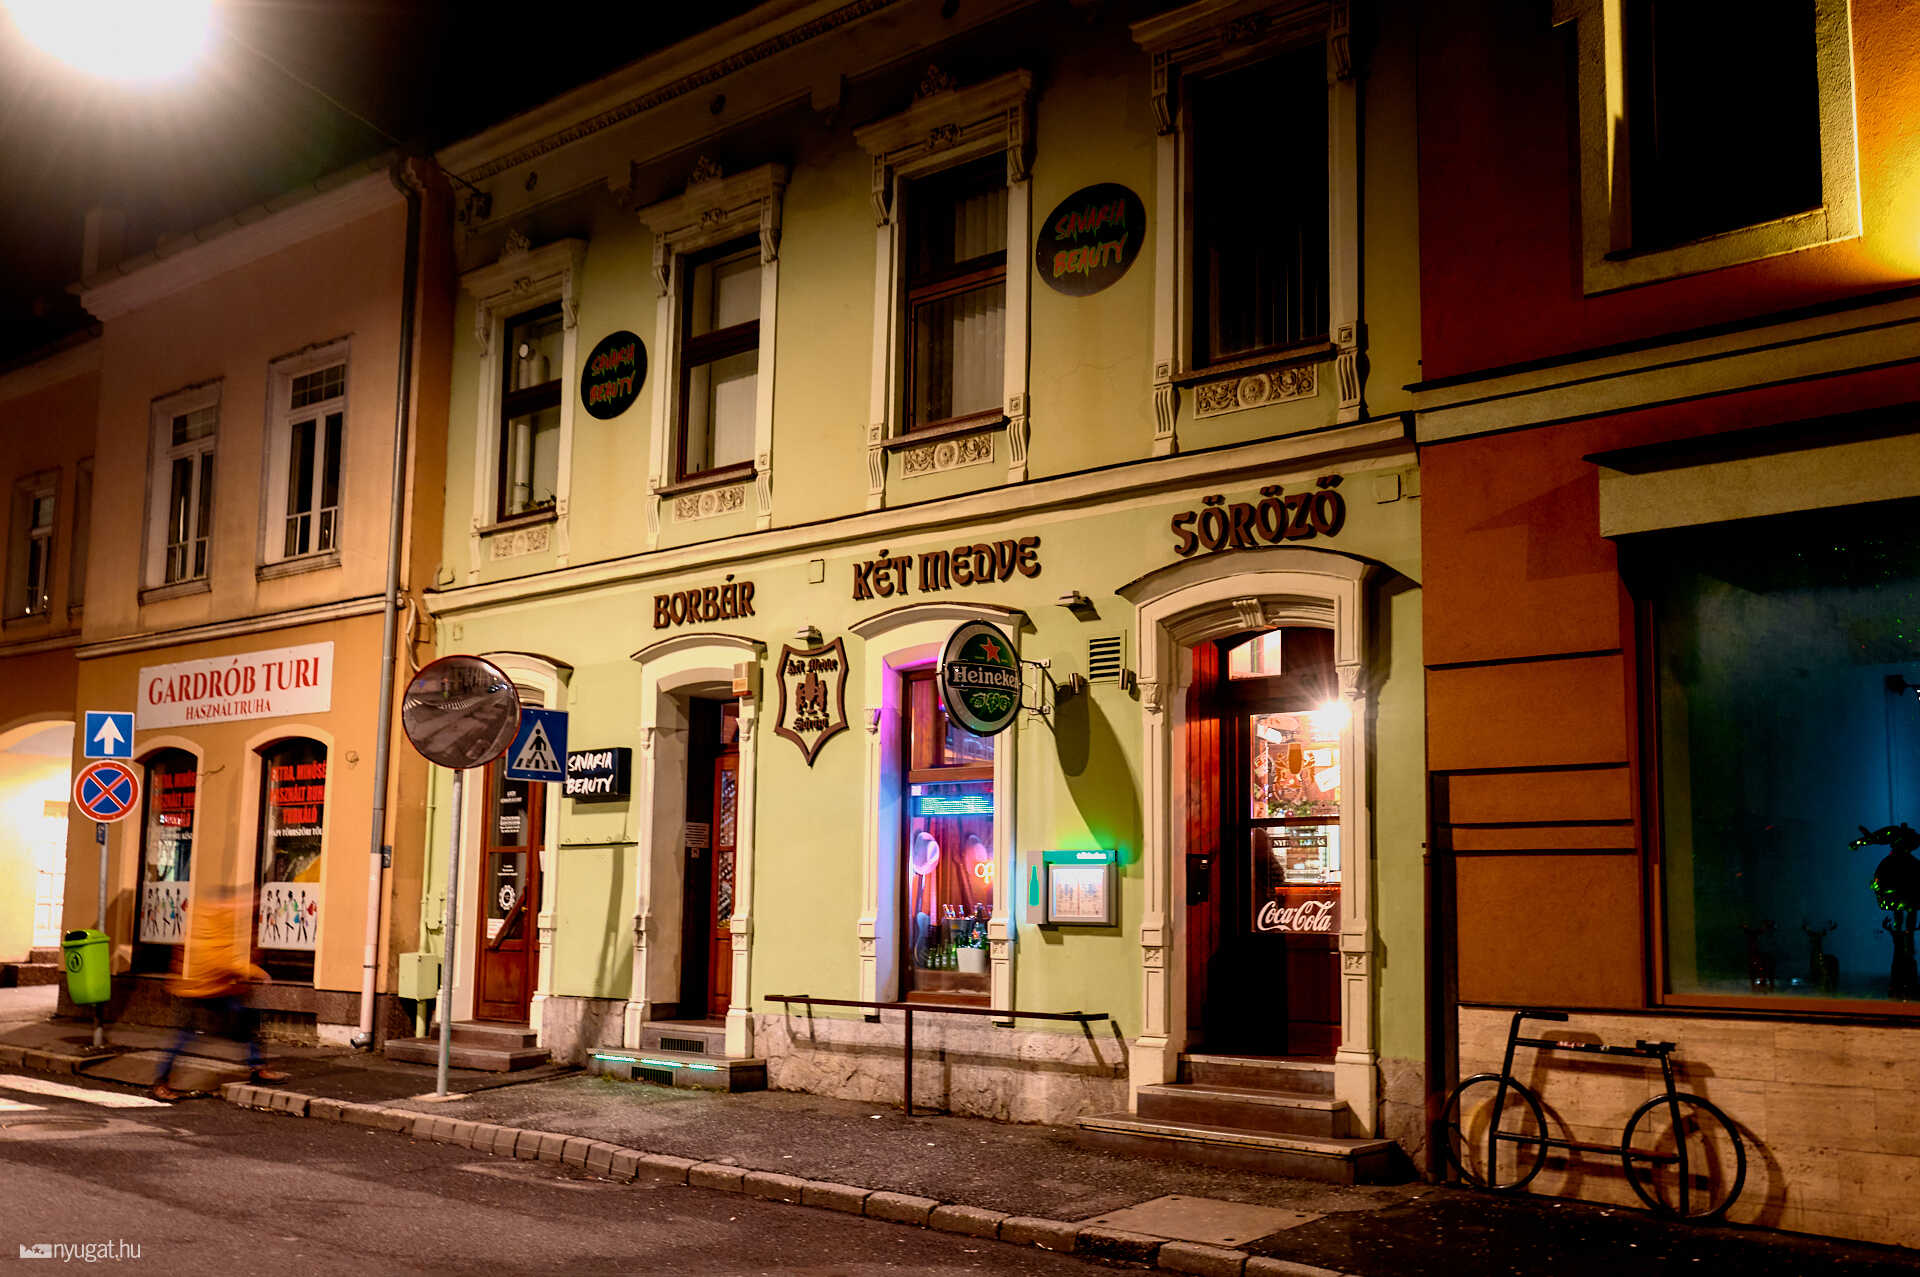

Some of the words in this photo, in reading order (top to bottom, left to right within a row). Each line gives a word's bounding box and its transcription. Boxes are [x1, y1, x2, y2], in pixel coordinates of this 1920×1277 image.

[1054, 232, 1128, 278] BEAUTY
[589, 370, 636, 406] BEAUTY
[852, 549, 913, 601] KÉT
[918, 536, 1042, 592] MEDVE
[653, 574, 755, 629] BORBÁR
[148, 658, 256, 706] GARDRÓB
[262, 657, 320, 692] TURI
[185, 698, 271, 721] HASZNÁLTRUHA
[568, 751, 612, 772] SAVARIA
[566, 774, 614, 795] BEAUTY
[1257, 900, 1336, 932] Coca-Cola
